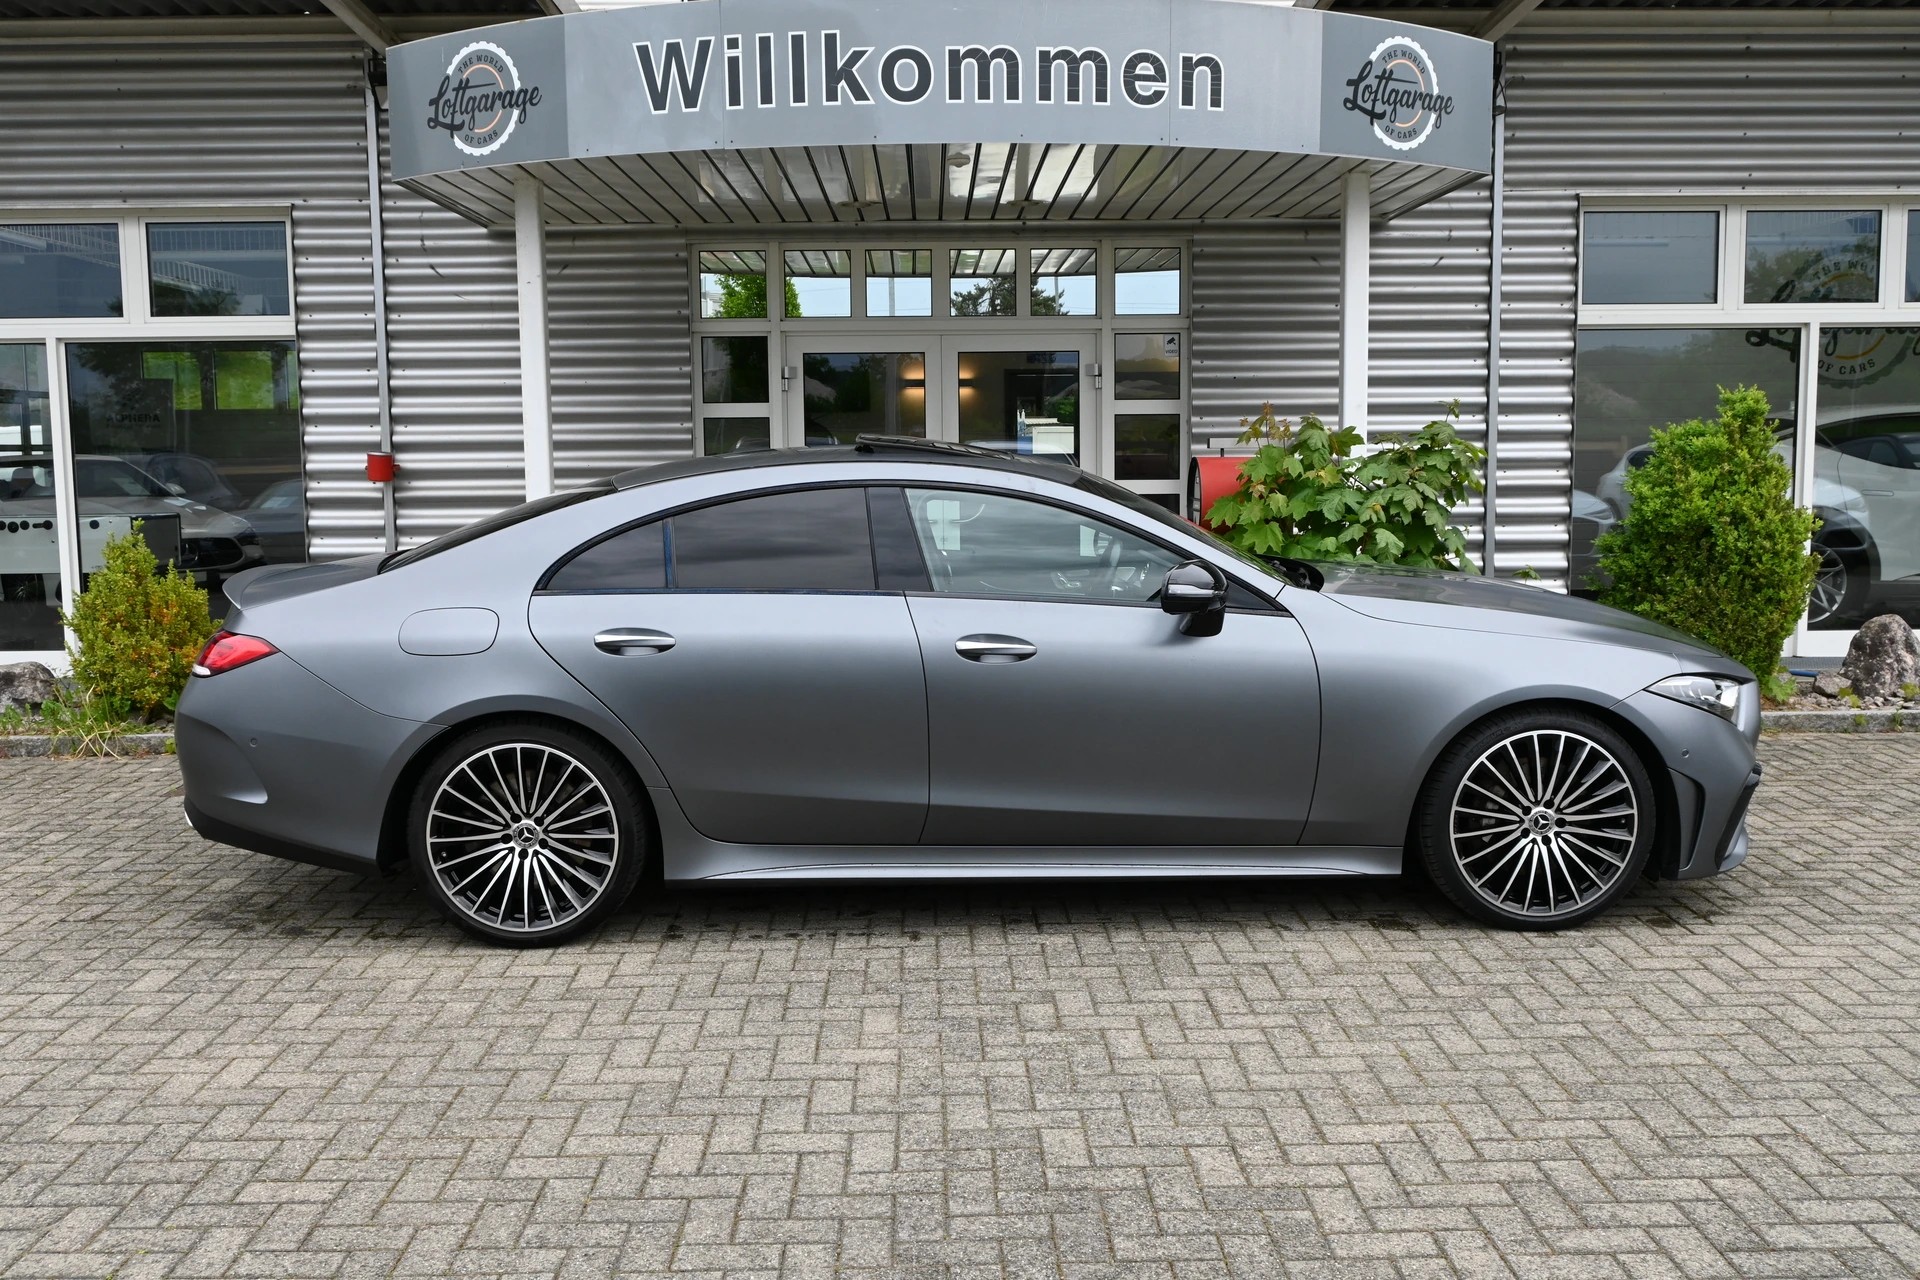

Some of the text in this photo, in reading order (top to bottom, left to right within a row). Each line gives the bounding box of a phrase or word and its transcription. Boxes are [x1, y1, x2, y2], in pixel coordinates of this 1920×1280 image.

[458, 54, 504, 73] THE WORLD
[632, 29, 1225, 115] Willkommen
[1382, 49, 1426, 75] THE WORLD
[1343, 60, 1454, 129] Loftgarage
[427, 75, 542, 139] Loftgarage
[464, 129, 498, 145] OF CARS
[1385, 125, 1418, 139] OF CARS
[1838, 358, 1876, 375] CARS
